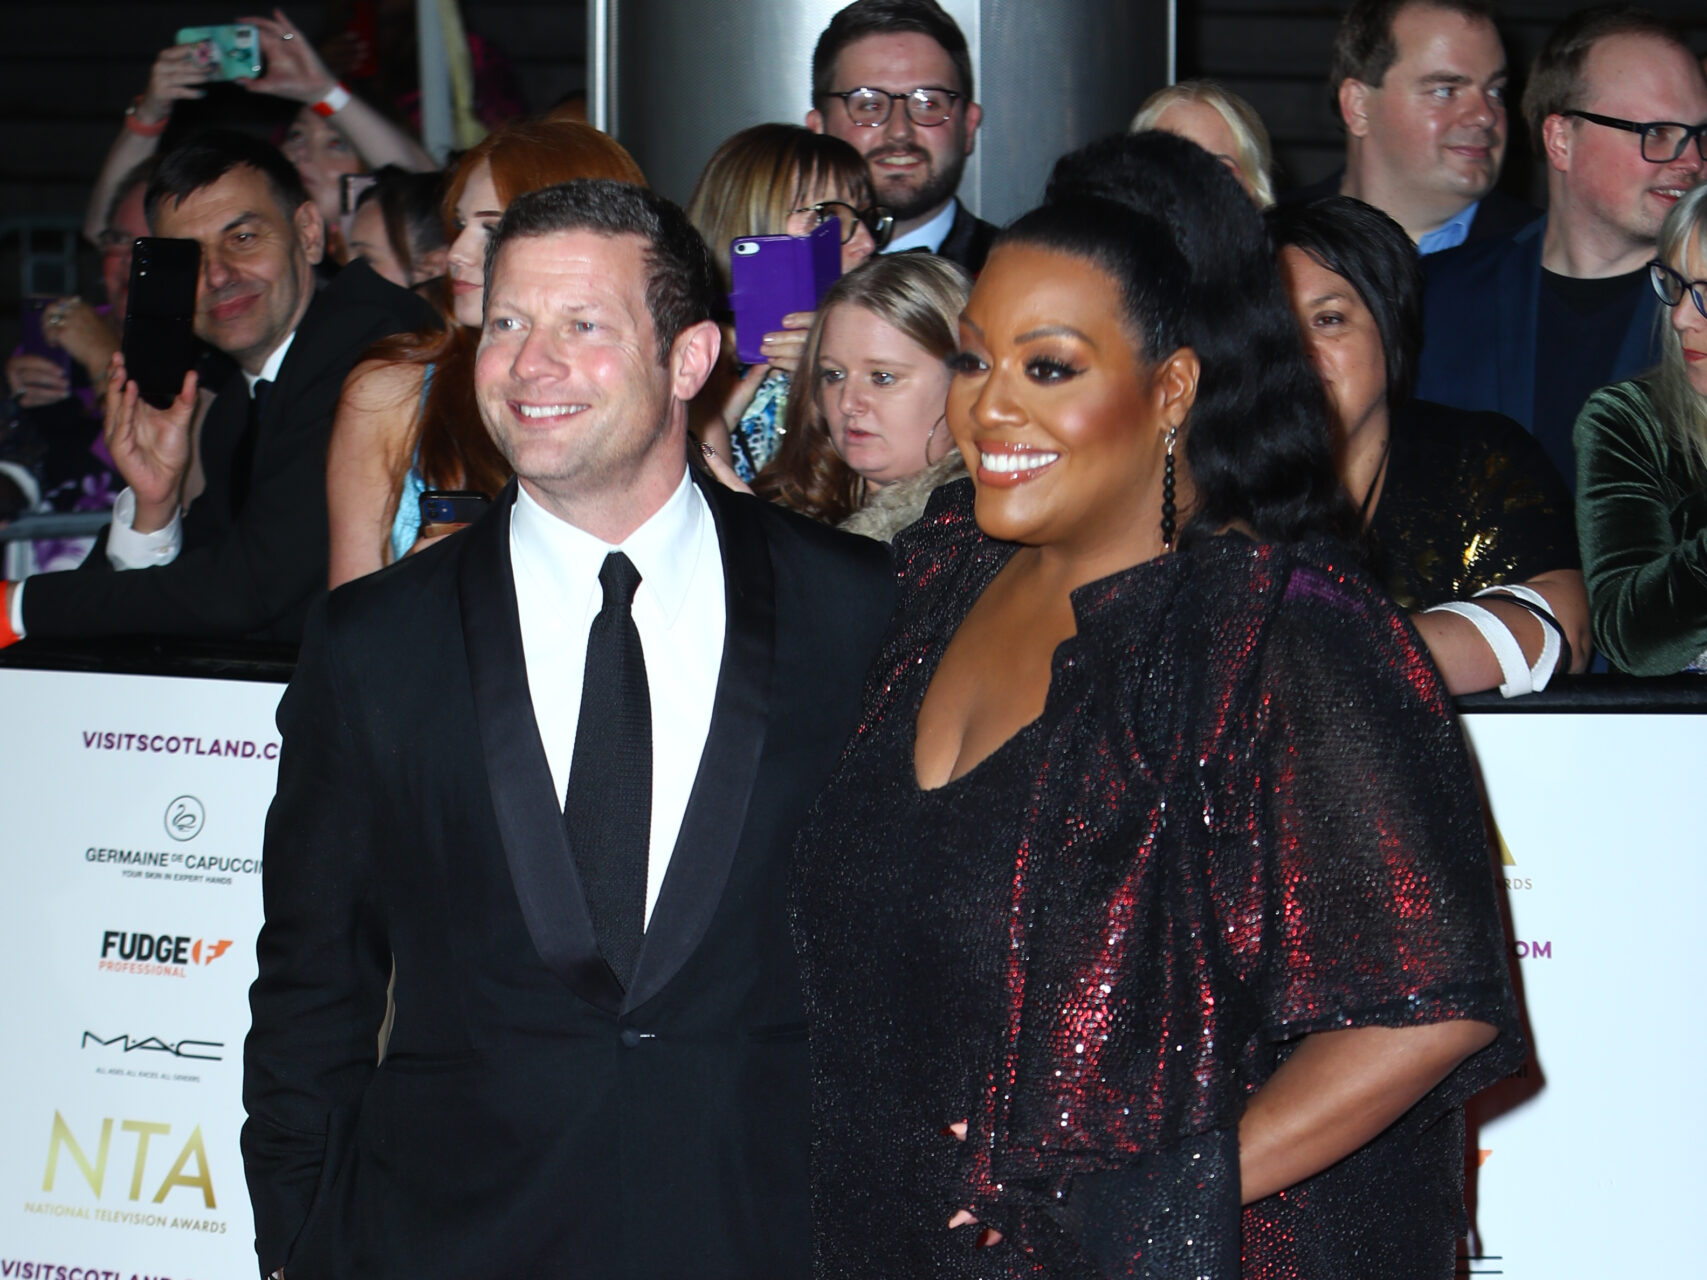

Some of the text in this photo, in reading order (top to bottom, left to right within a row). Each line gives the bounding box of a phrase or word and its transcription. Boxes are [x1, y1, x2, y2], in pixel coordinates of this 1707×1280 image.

[82, 730, 279, 760] VISITSCOTLAND.C
[85, 848, 169, 867] GERMAINE
[171, 853, 183, 863] DE
[122, 870, 142, 878] YOUR
[173, 873, 203, 883] EXPERT
[101, 930, 191, 965] FUDGE
[98, 961, 187, 979] PROFESSIONAL
[42, 1108, 217, 1210] NTA
[24, 1201, 227, 1234] NATIONAL TELEVISION AWARDS
